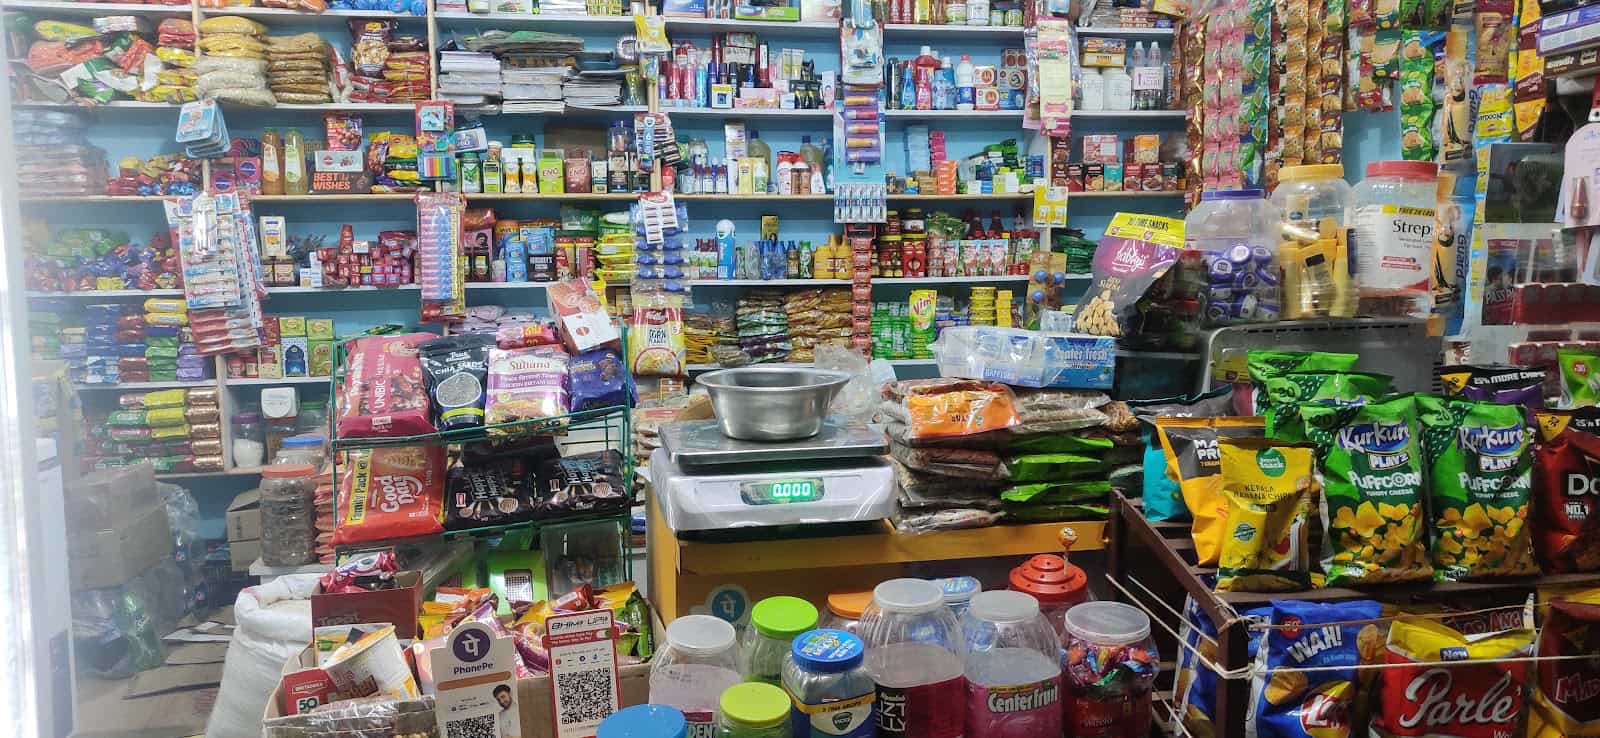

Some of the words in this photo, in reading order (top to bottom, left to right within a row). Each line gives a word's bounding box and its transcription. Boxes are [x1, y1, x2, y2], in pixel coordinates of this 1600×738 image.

[1467, 88, 1479, 135] Guard
[313, 172, 338, 182] BEST
[543, 168, 560, 177] ENO
[313, 181, 352, 190] WISHES
[1393, 219, 1433, 238] Strep
[1455, 234, 1467, 280] Guard
[913, 297, 931, 315] Vim
[1085, 348, 1108, 362] fresh
[434, 366, 458, 376] CHIA
[1491, 372, 1520, 384] MORE
[374, 379, 386, 409] UNIBIC
[1340, 419, 1410, 452] Kurkure
[1457, 425, 1525, 453] Kurkure
[1197, 448, 1221, 461] PR
[355, 472, 368, 493] Pack
[1350, 471, 1422, 490] PUFFCORN
[374, 475, 401, 513] Good
[351, 496, 366, 522] Family
[1563, 503, 1589, 515] NO.1
[462, 633, 481, 657] पे
[1286, 624, 1343, 663] WAH!
[1442, 648, 1468, 660] New
[453, 662, 494, 675] PhonePe
